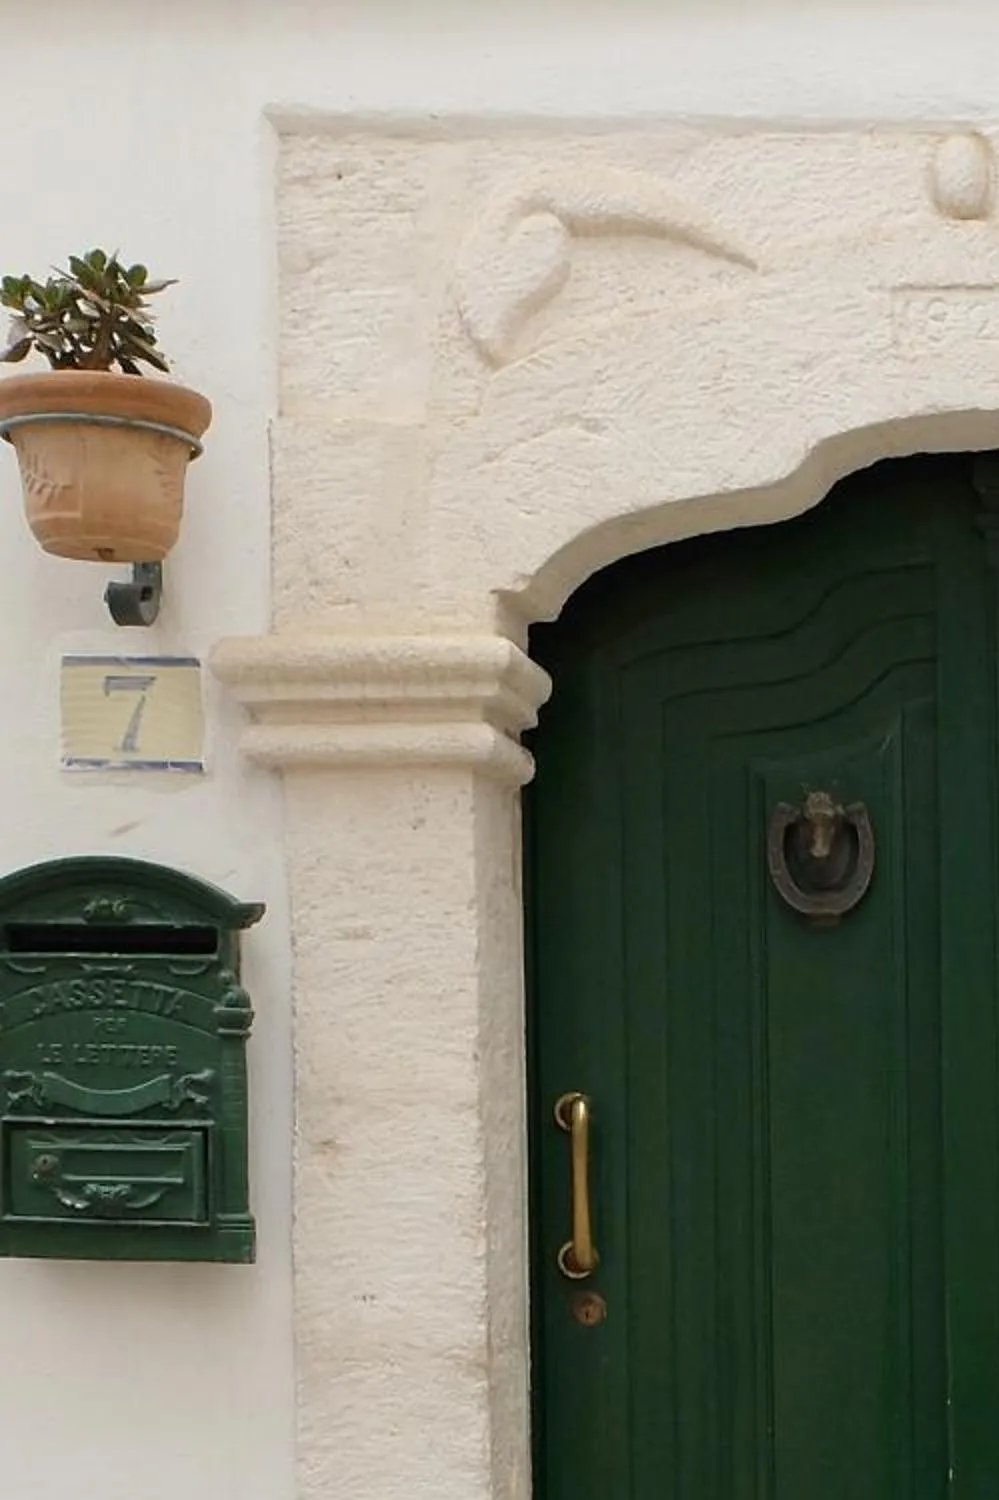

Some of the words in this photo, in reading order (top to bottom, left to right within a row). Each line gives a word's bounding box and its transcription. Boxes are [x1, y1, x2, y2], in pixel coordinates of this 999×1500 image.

[104, 676, 157, 752] 7
[31, 979, 187, 1015] CASSETTA
[37, 1043, 63, 1065] LE
